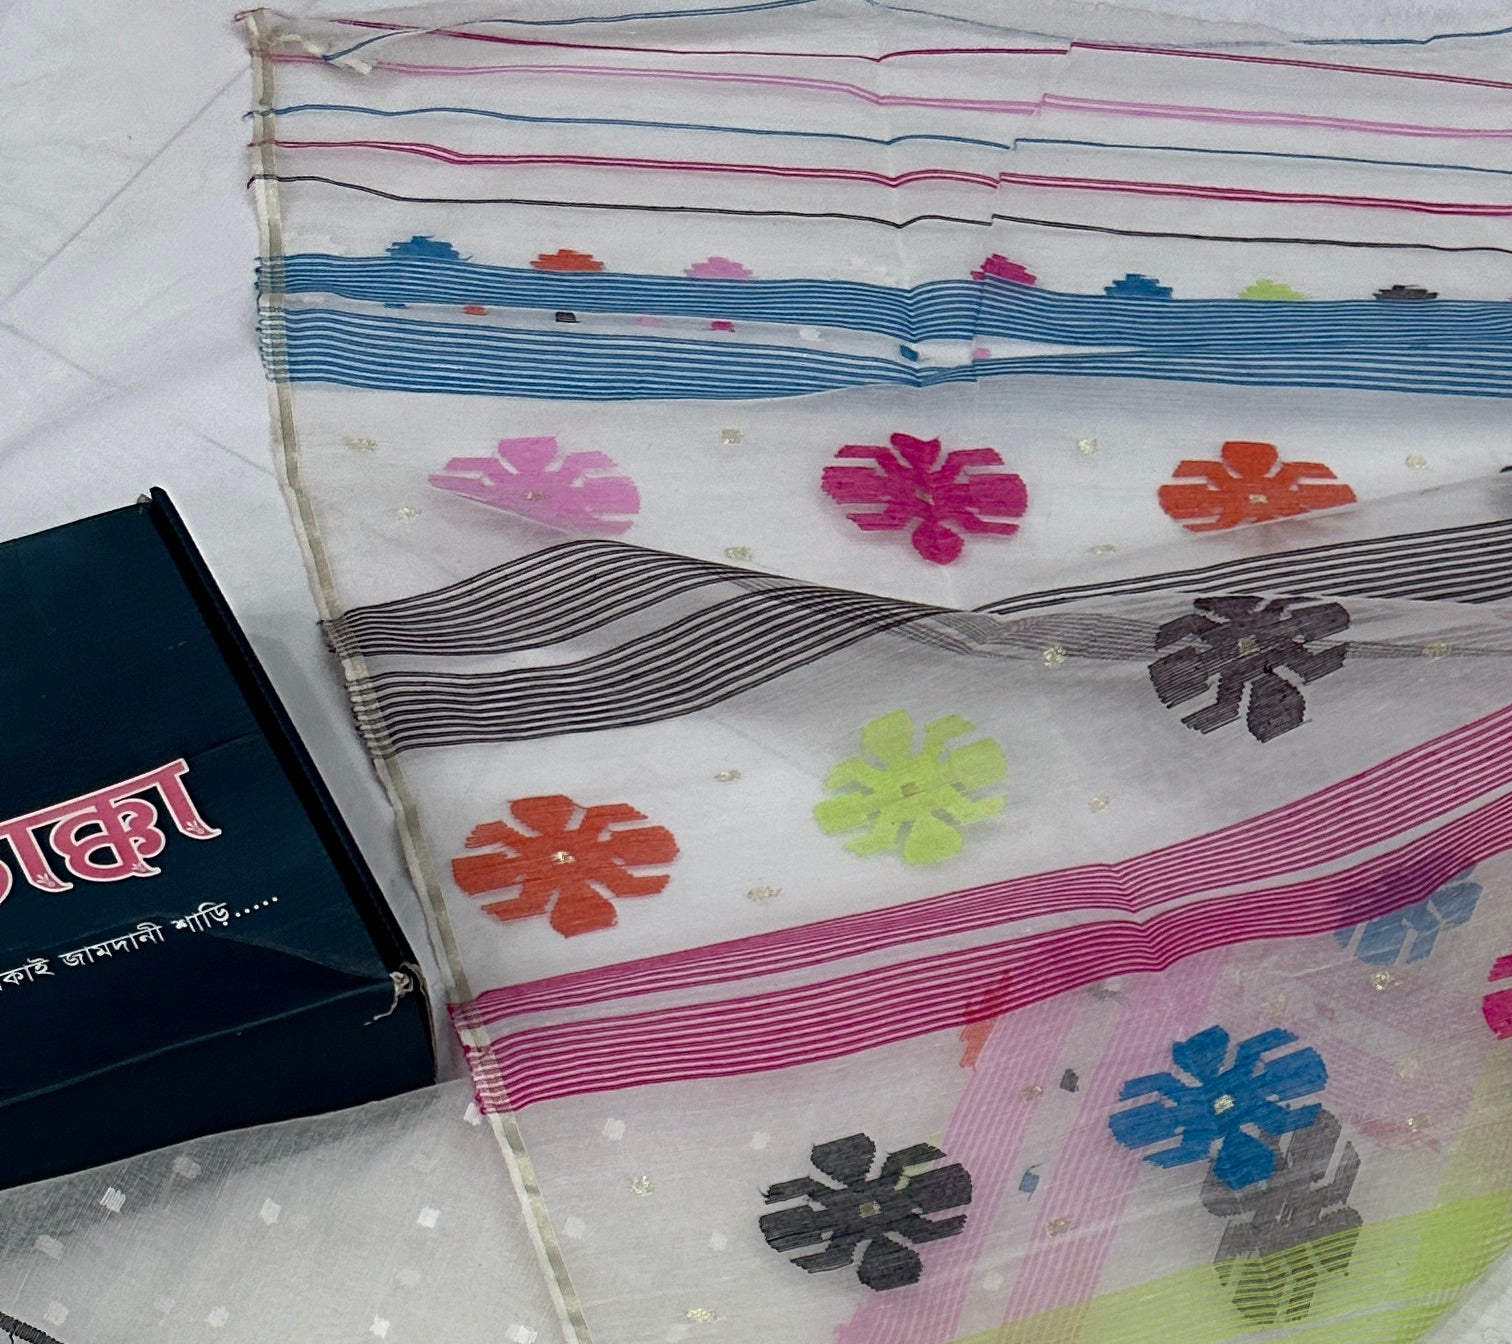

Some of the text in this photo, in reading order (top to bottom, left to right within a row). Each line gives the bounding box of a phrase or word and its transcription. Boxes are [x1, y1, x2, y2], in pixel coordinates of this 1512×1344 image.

[0, 757, 223, 905] াক্কা
[0, 957, 56, 991] কাই
[57, 921, 166, 967] জামদানী
